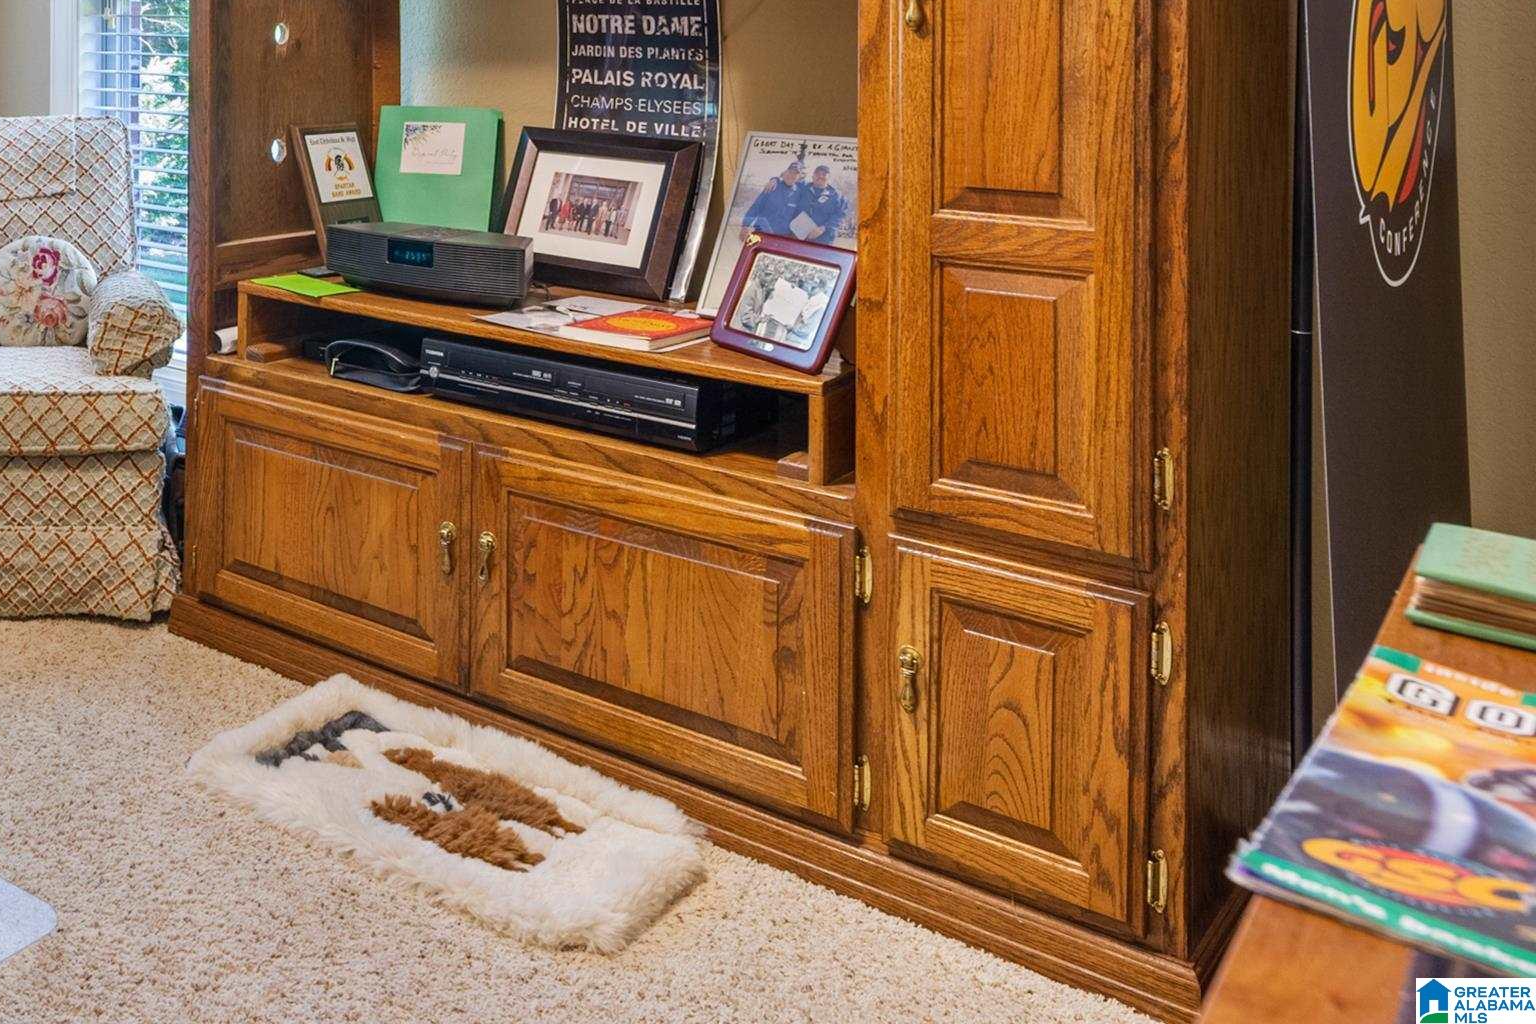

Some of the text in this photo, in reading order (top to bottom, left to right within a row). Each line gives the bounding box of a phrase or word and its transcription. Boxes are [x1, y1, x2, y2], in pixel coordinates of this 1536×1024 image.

[571, 13, 703, 37] NOTRE DAME
[571, 44, 705, 62] JARDIN DES PLANTES
[571, 68, 705, 90] PALAIS ROYAL
[567, 116, 702, 139] HOTEL DE VILLE
[1302, 837, 1534, 915] GSC
